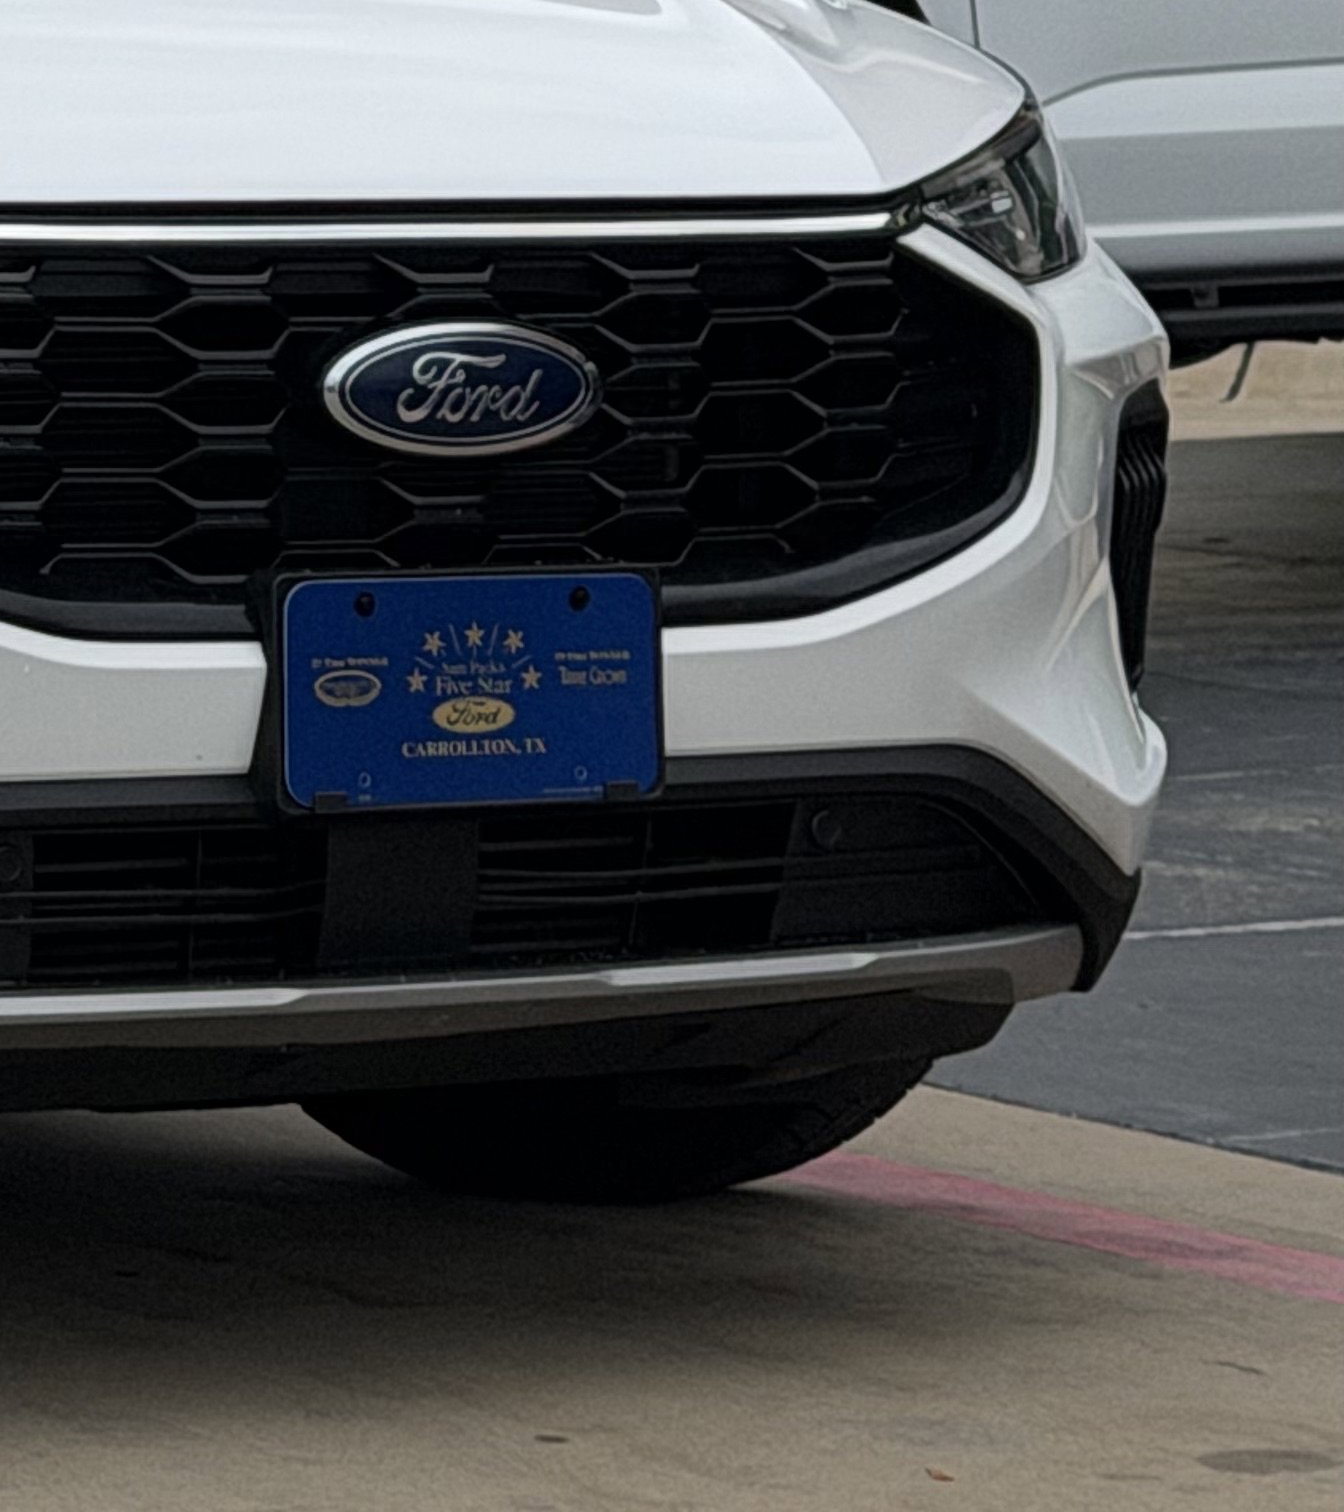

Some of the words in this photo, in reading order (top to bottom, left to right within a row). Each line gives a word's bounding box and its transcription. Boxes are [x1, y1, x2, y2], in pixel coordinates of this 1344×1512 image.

[396, 351, 543, 423] Ford
[435, 675, 473, 697] Five
[477, 676, 514, 695] Star
[445, 700, 501, 727] Ford
[524, 737, 547, 755] TX
